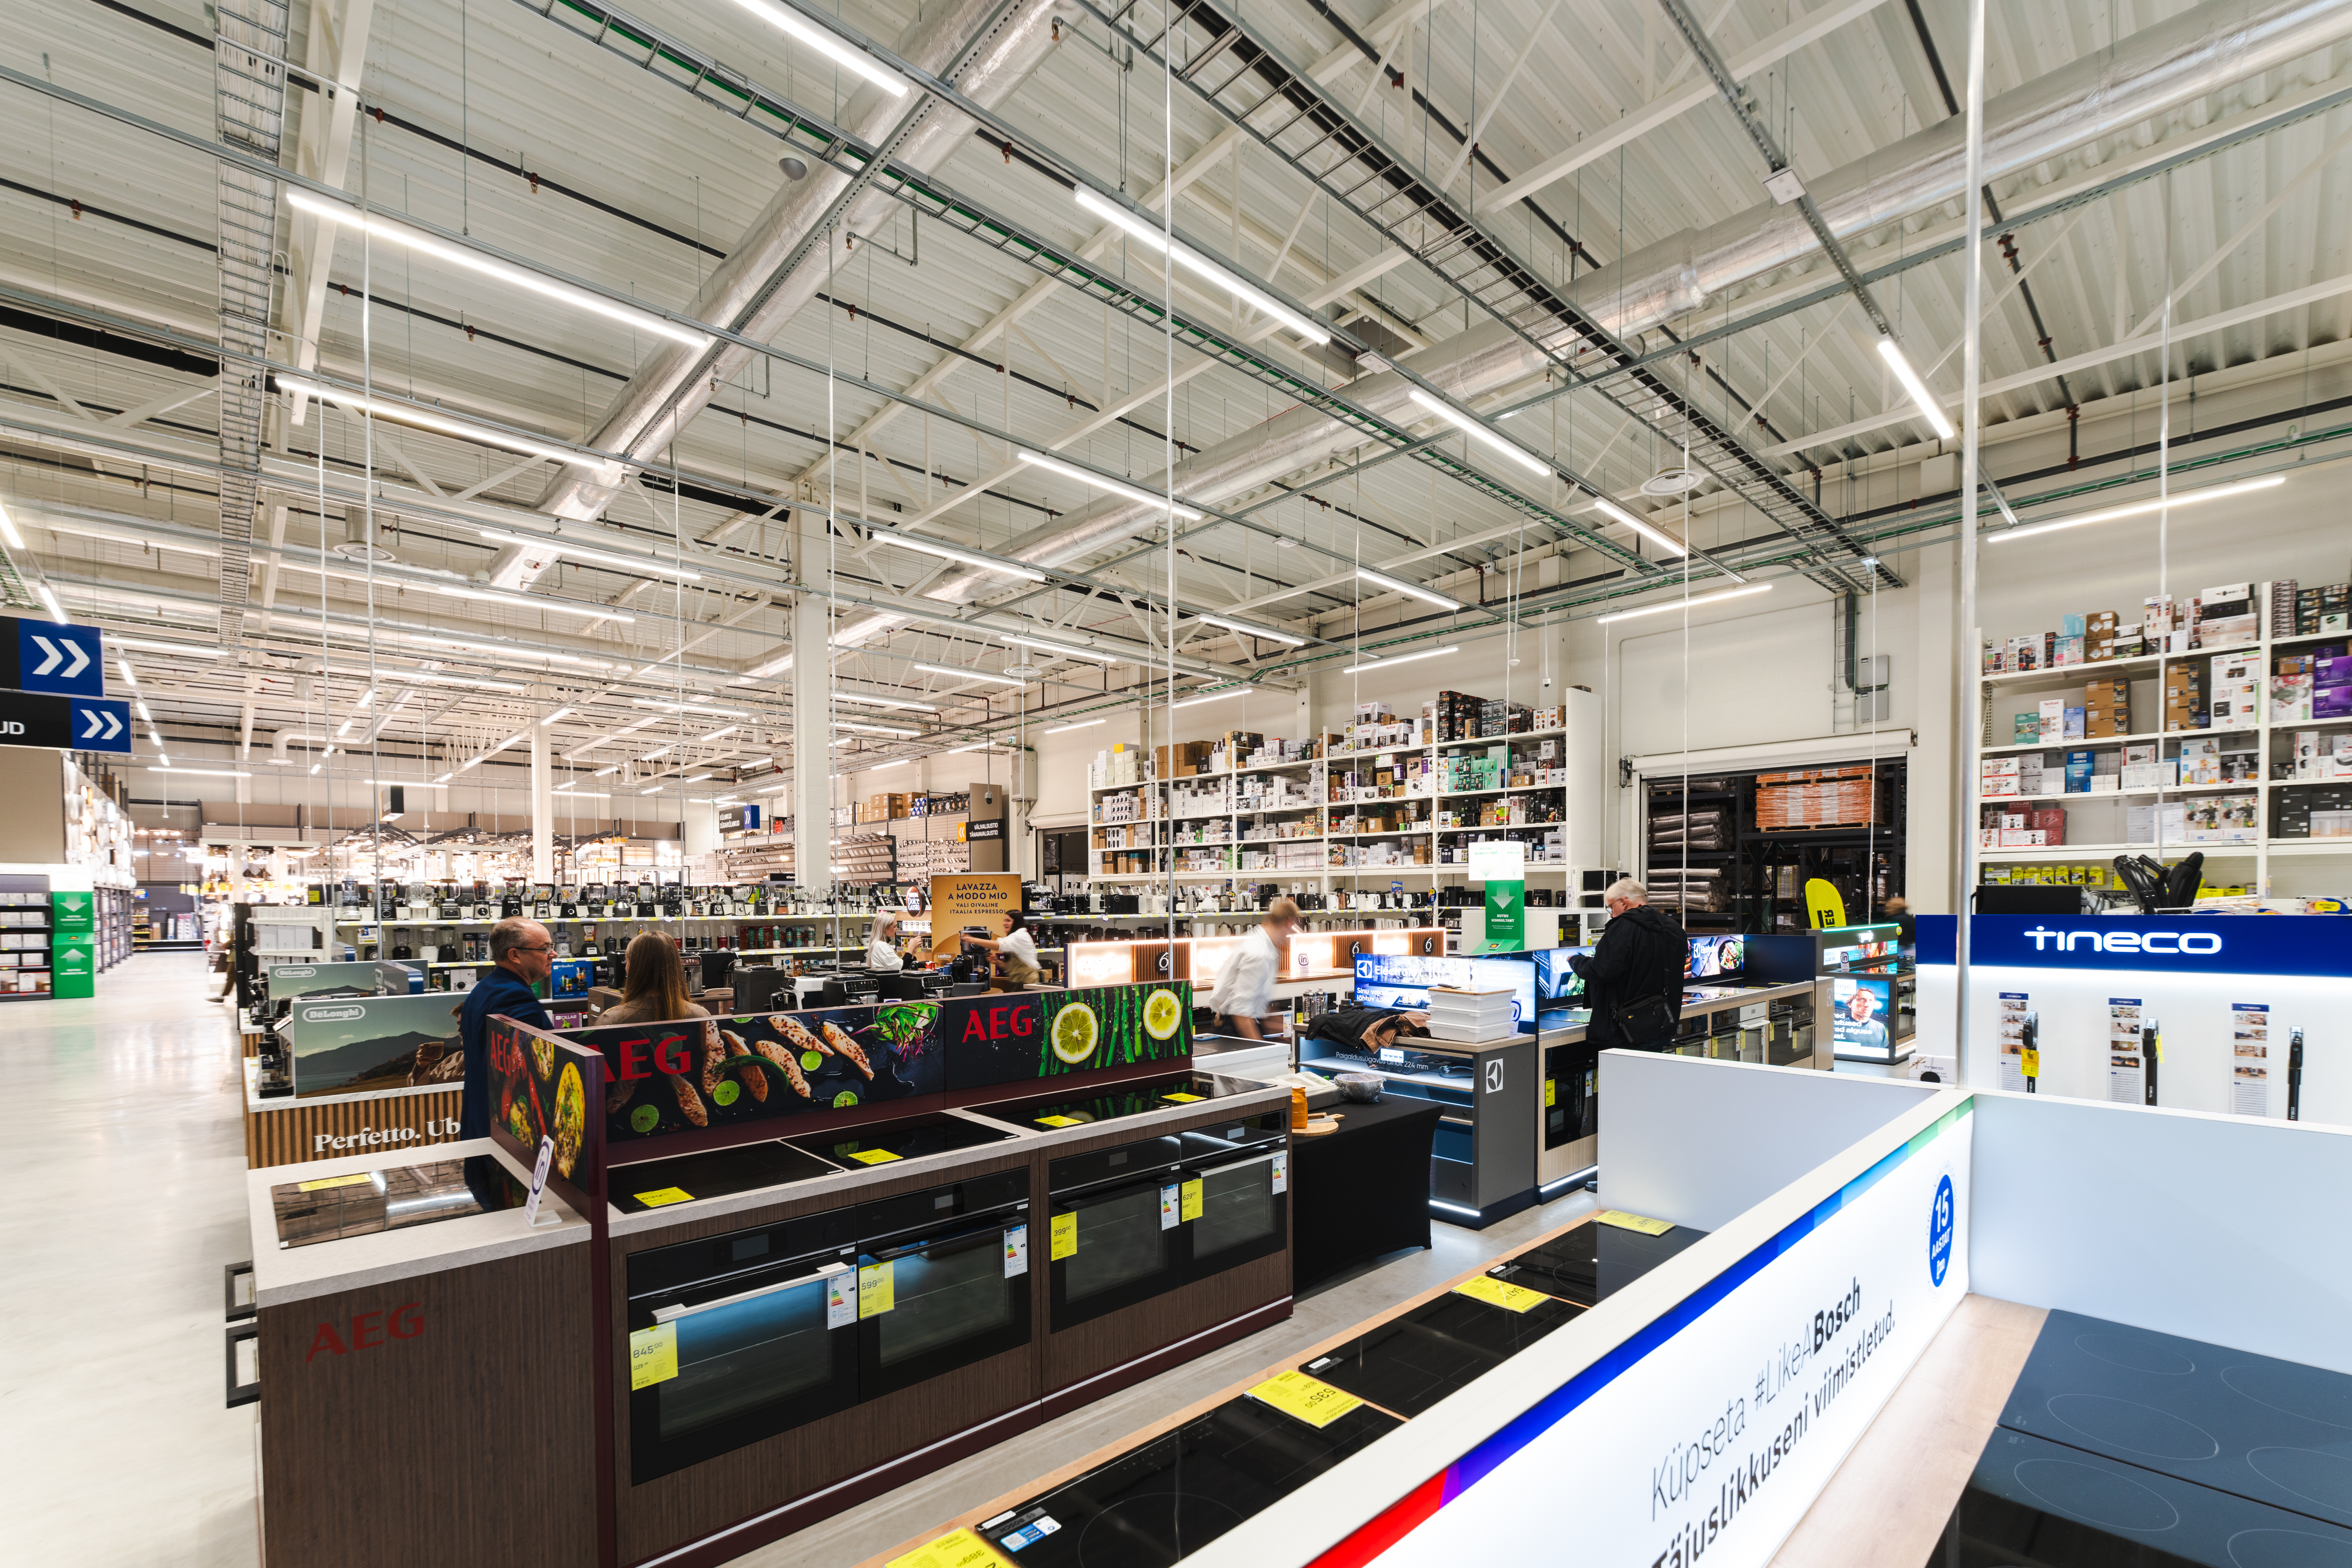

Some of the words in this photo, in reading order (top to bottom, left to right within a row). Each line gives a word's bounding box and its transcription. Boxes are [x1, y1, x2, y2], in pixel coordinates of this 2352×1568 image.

[1823, 910, 1835, 928] ER
[279, 968, 312, 977] DeLonghi
[1159, 951, 1169, 969] 6
[1375, 965, 1422, 978] Electrolux
[1357, 994, 1375, 1002] lähtuv
[309, 1008, 359, 1019] DeLonghi
[963, 1005, 1033, 1043] AEG
[490, 1031, 512, 1077] AEG
[313, 1126, 422, 1152] Perfetto.
[1935, 1187, 1949, 1233] 15
[1932, 1226, 1952, 1260] AASTAT
[305, 1301, 425, 1363] AEG
[1815, 1299, 1896, 1418] viimistletud.
[1652, 1397, 1745, 1522] Küpseta
[1754, 1276, 1860, 1411] #LikeABosch
[1000, 1517, 1025, 1533] BOSCH
